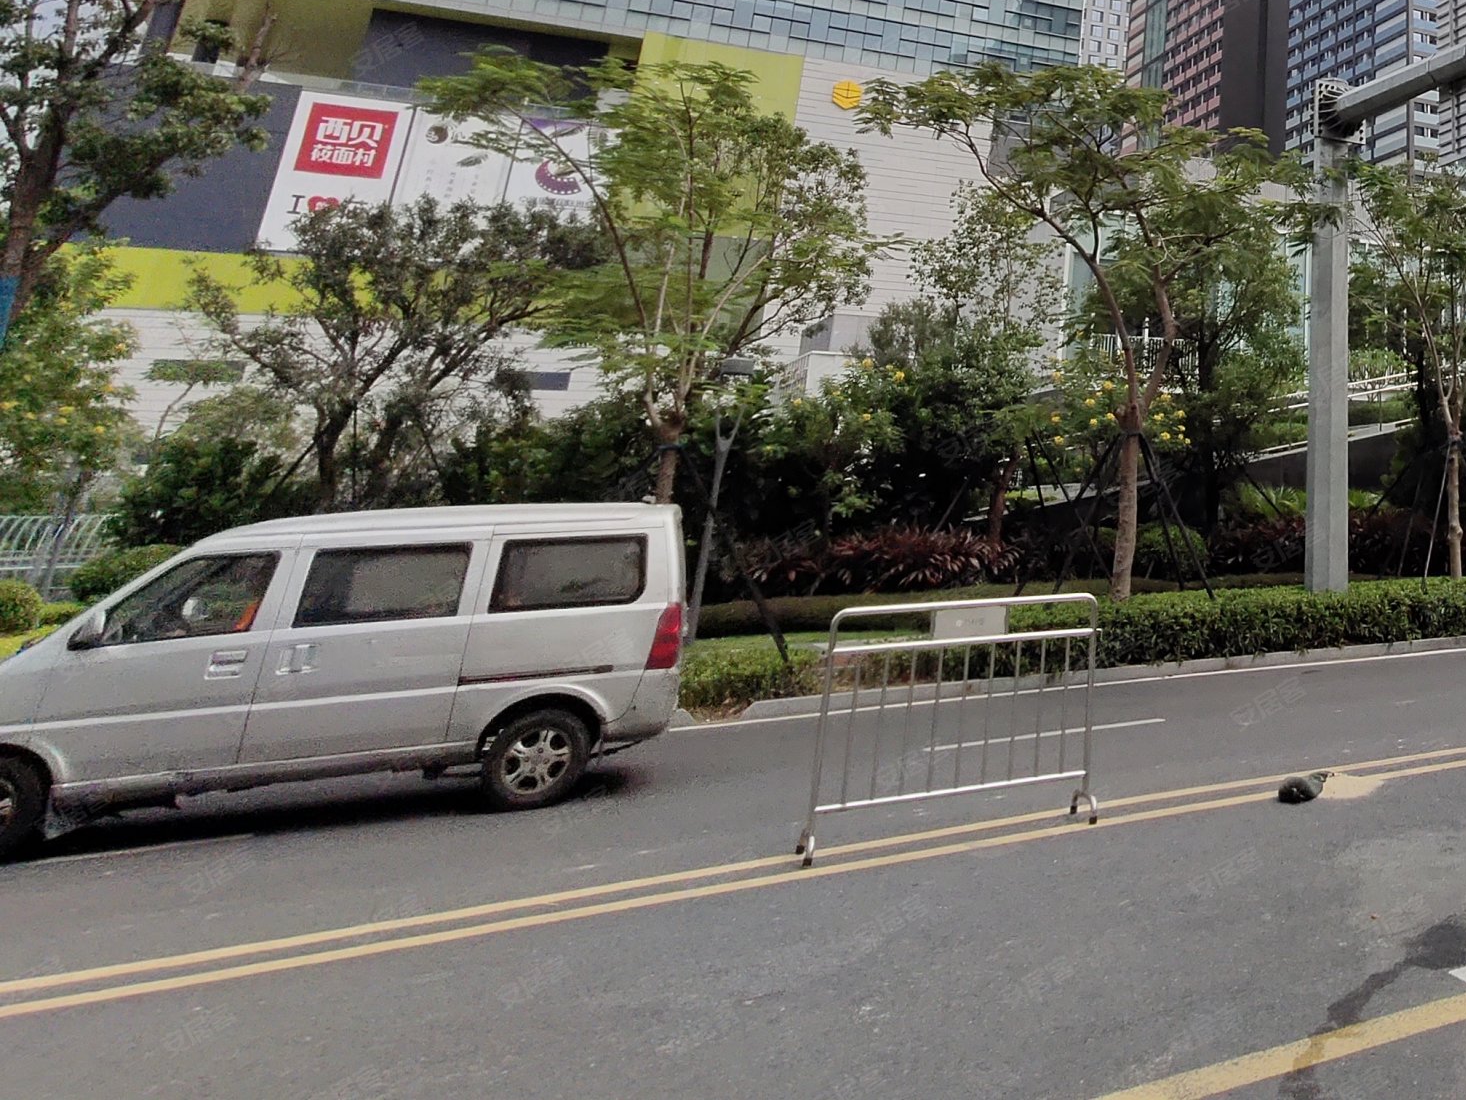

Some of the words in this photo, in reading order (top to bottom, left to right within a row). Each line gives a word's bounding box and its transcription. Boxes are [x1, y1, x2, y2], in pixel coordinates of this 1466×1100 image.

[315, 116, 383, 147] 西贝
[310, 143, 377, 167] 莜面村
